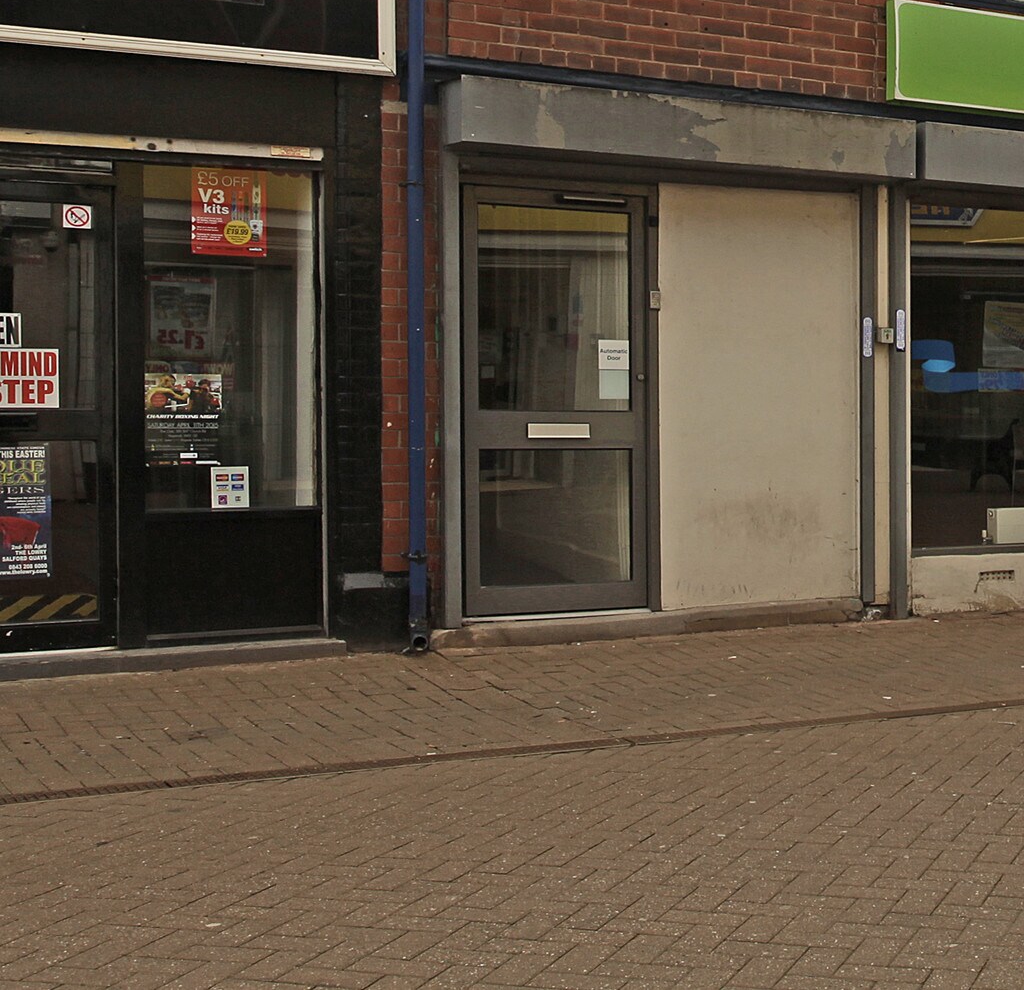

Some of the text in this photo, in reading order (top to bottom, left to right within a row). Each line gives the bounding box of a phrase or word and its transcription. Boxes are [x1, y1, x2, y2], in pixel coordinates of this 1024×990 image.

[197, 171, 249, 187] £5 OFF
[198, 188, 225, 204] V3
[203, 204, 230, 215] kits
[0, 351, 57, 377] MIND
[0, 379, 54, 404] TEP
[15, 450, 46, 458] EASTER!
[0, 486, 44, 494] ERS
